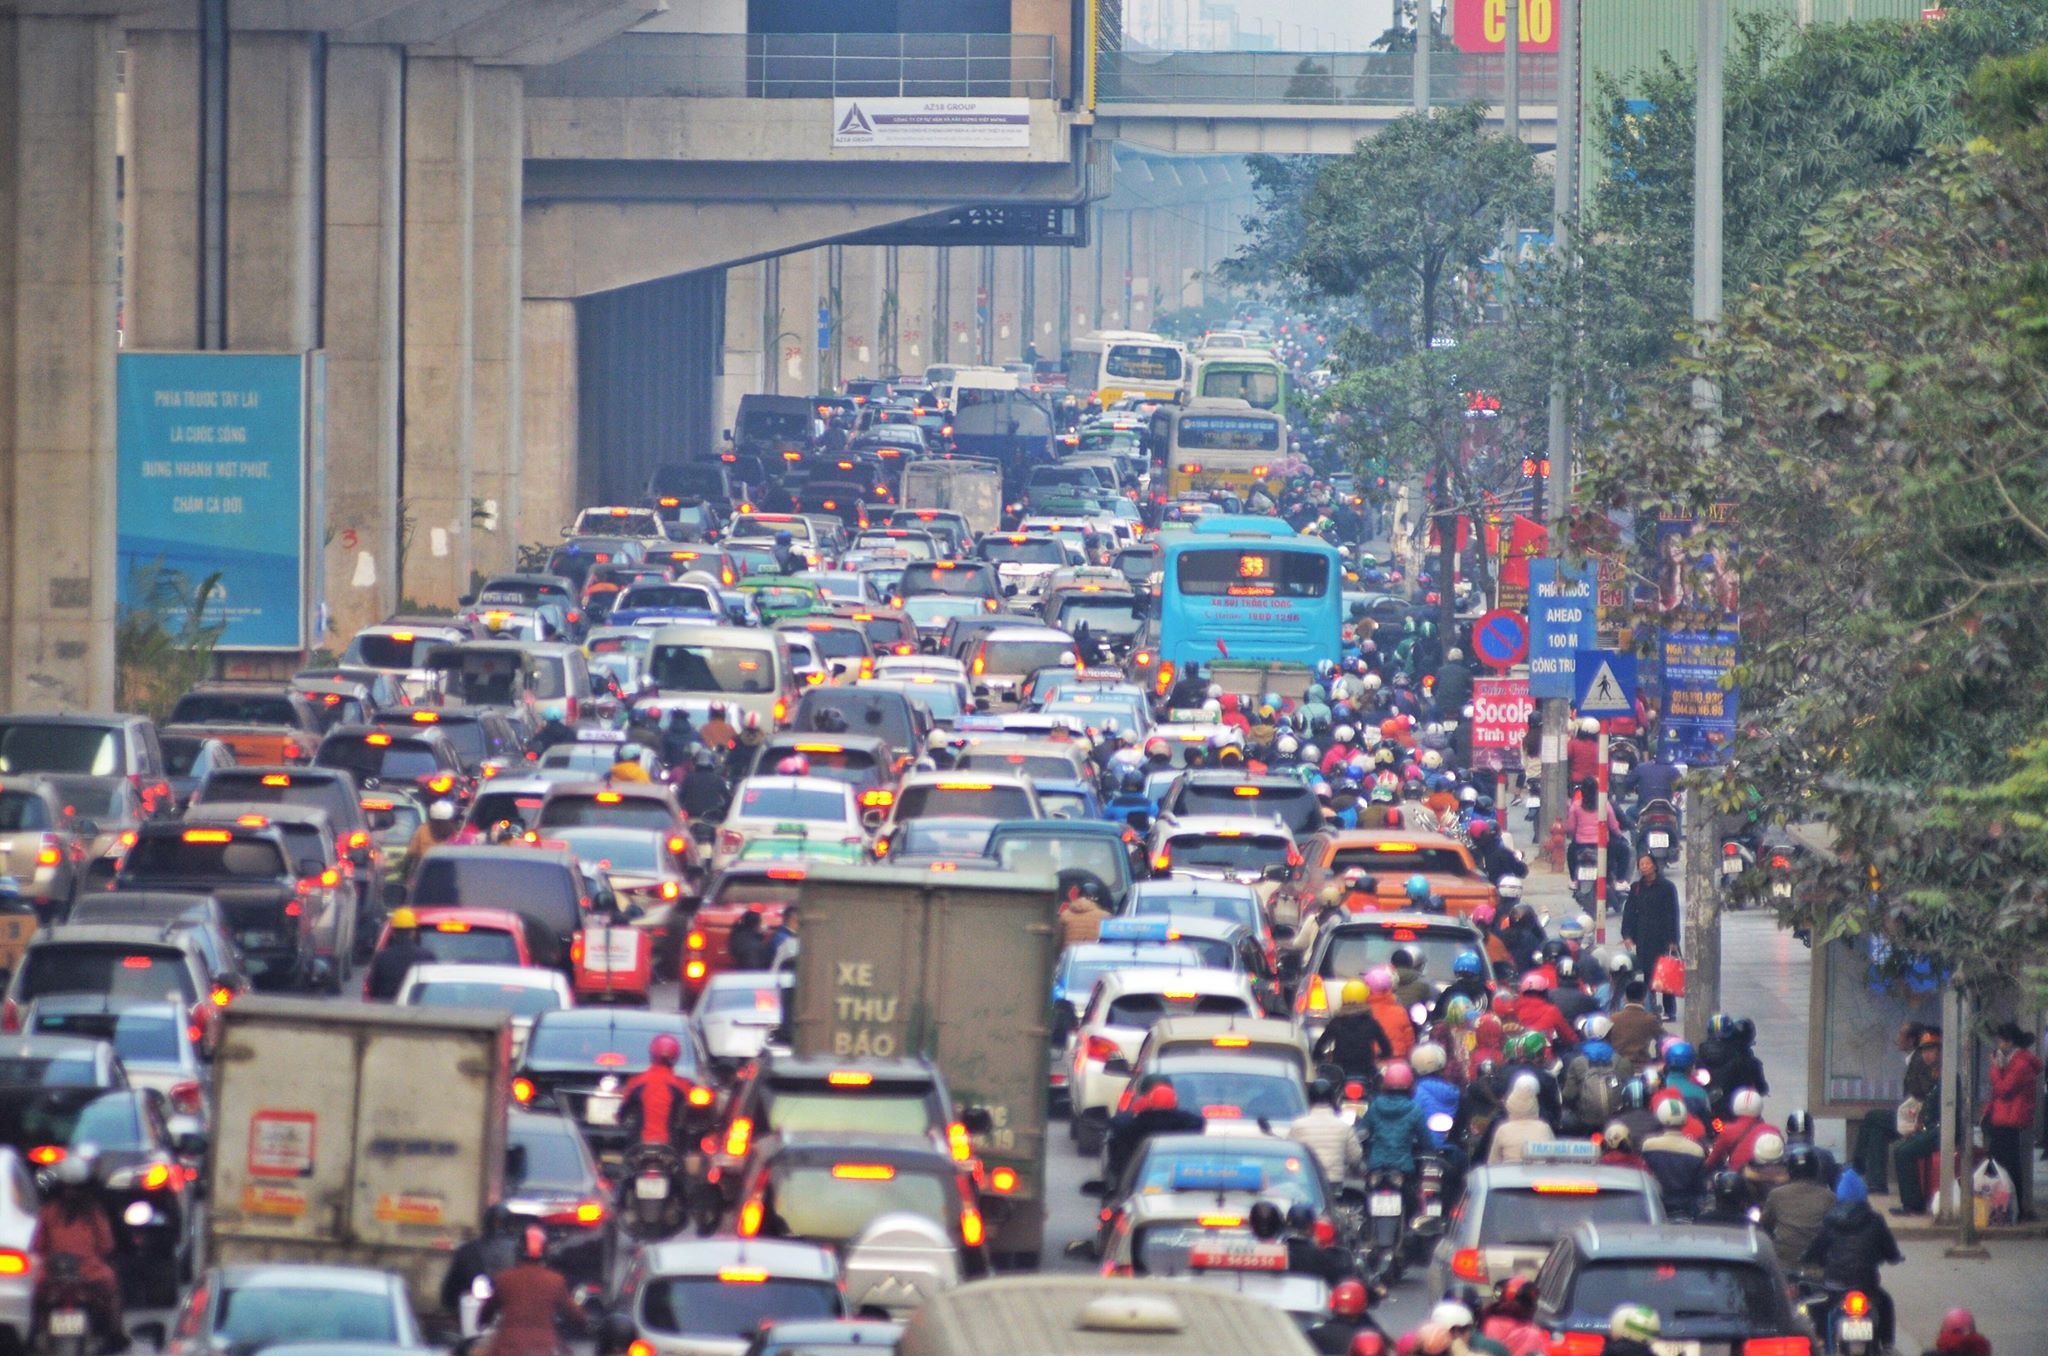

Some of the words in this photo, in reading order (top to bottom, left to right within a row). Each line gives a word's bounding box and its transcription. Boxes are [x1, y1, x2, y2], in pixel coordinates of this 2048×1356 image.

[947, 103, 976, 111] GROUP
[1547, 608, 1582, 622] AHEAD
[1549, 634, 1567, 648] 100
[1569, 633, 1578, 648] M
[1532, 657, 1557, 673] CÔNG
[838, 962, 873, 987] XE
[834, 1028, 896, 1057] BÁO
